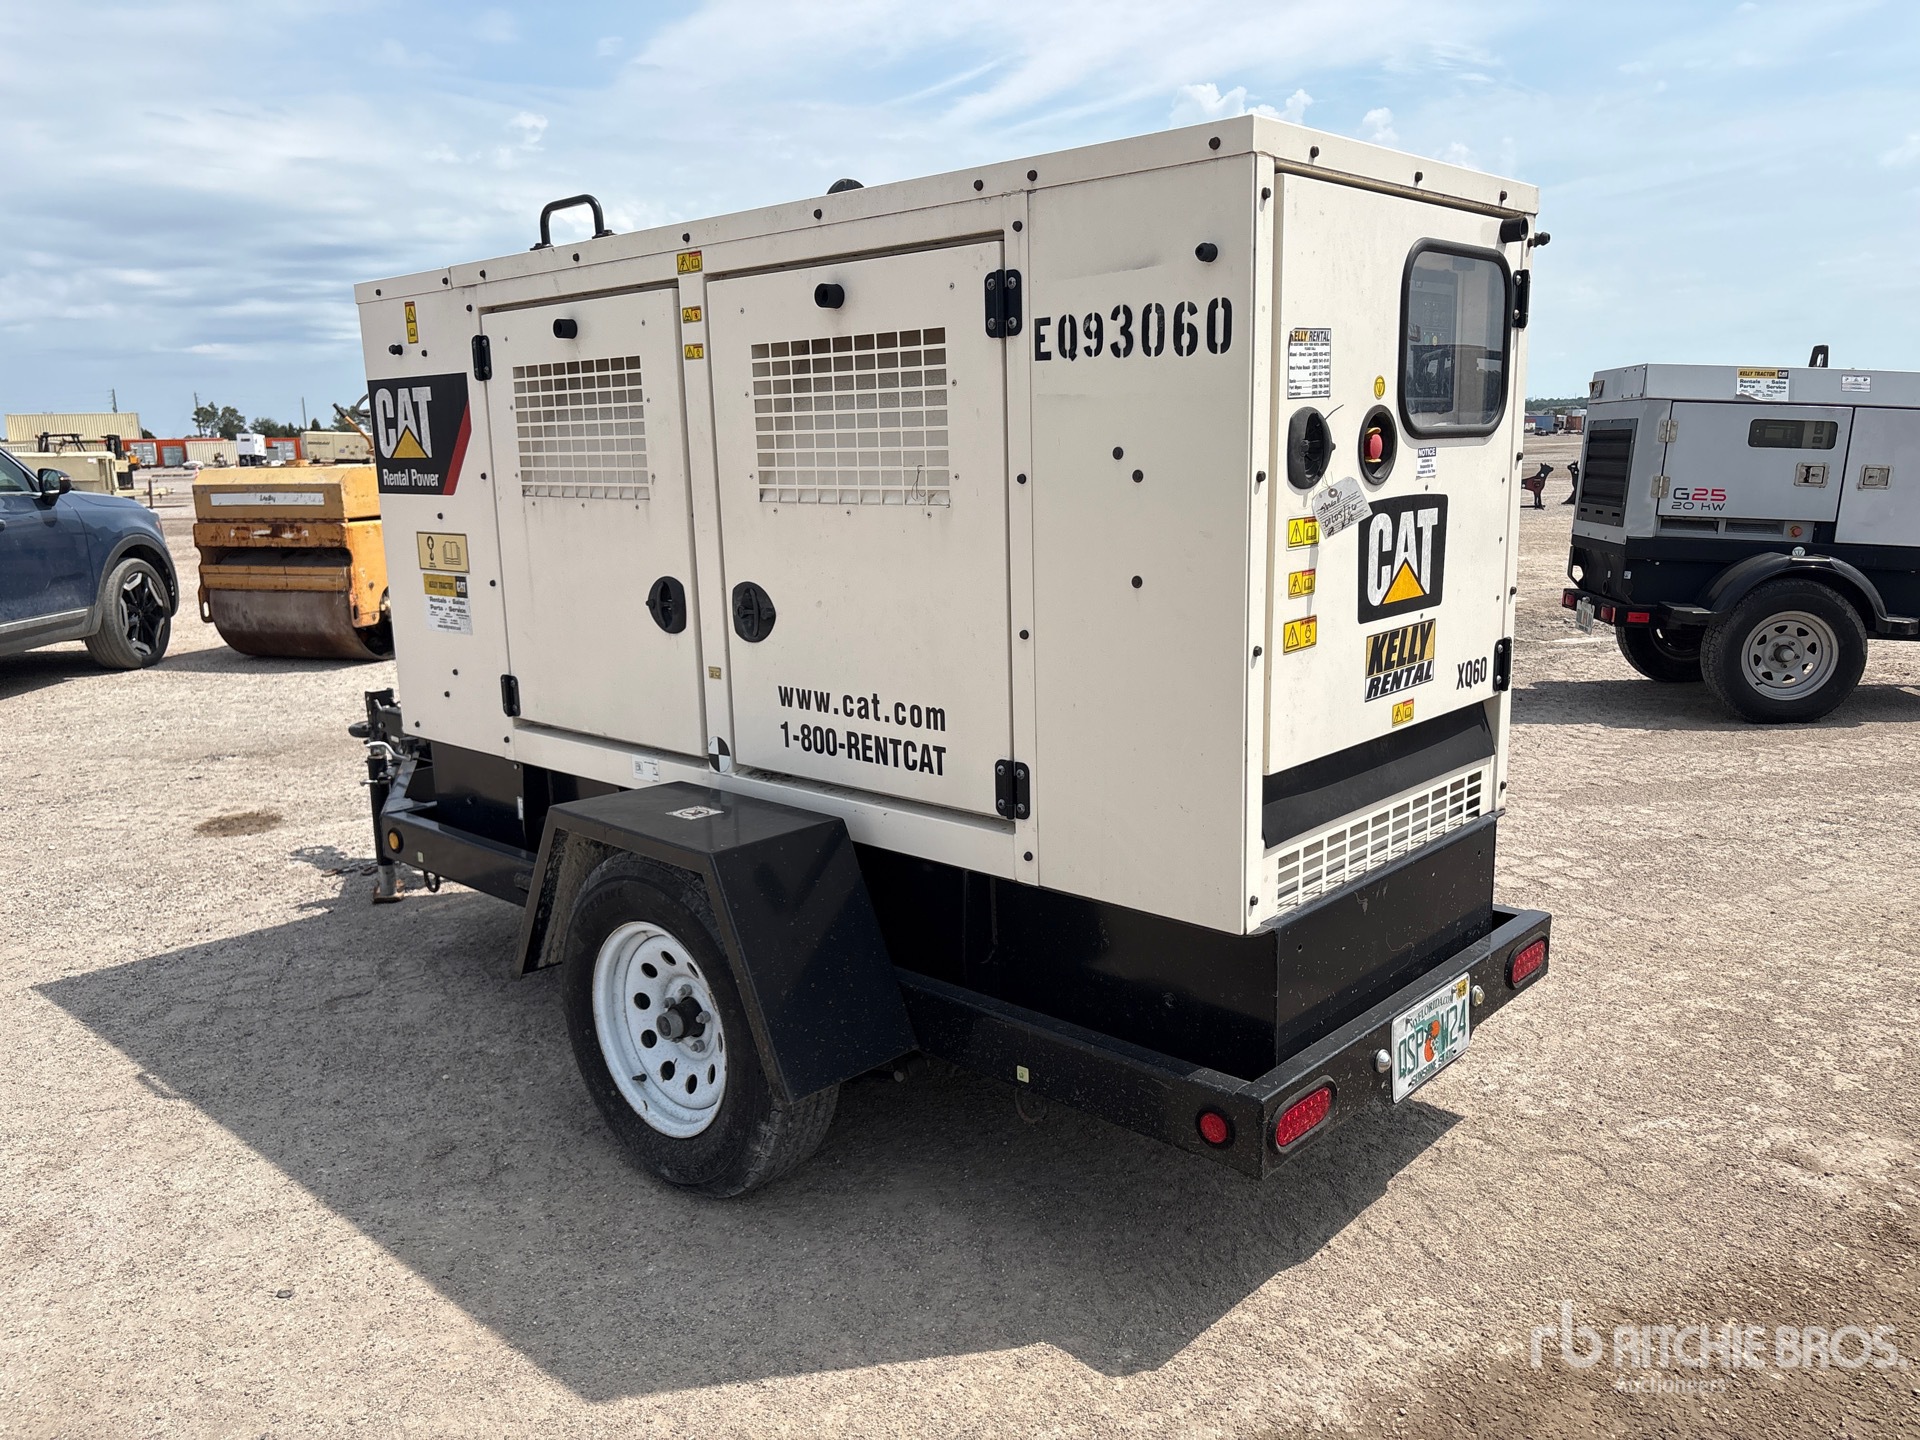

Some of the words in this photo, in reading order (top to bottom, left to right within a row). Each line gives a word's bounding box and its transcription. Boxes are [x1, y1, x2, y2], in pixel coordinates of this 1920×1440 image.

[1034, 296, 1233, 362] EQ93060
[1309, 331, 1330, 341] RENTAL
[375, 386, 433, 459] CAT
[1418, 447, 1436, 457] NOTICE
[382, 468, 409, 486] Rental
[411, 468, 440, 487] Power
[1673, 487, 1727, 502] G25
[1671, 502, 1695, 511] 20
[1367, 507, 1439, 607] CAT
[429, 596, 447, 604] Rentals
[452, 598, 466, 606] Sales
[448, 605, 467, 614] Service
[1367, 620, 1434, 676] KELLY
[1366, 661, 1433, 699] RENTAL
[1456, 656, 1488, 691] XQ60
[778, 685, 947, 732] www.cat.com
[780, 721, 947, 776] 1-800-RENTCAT
